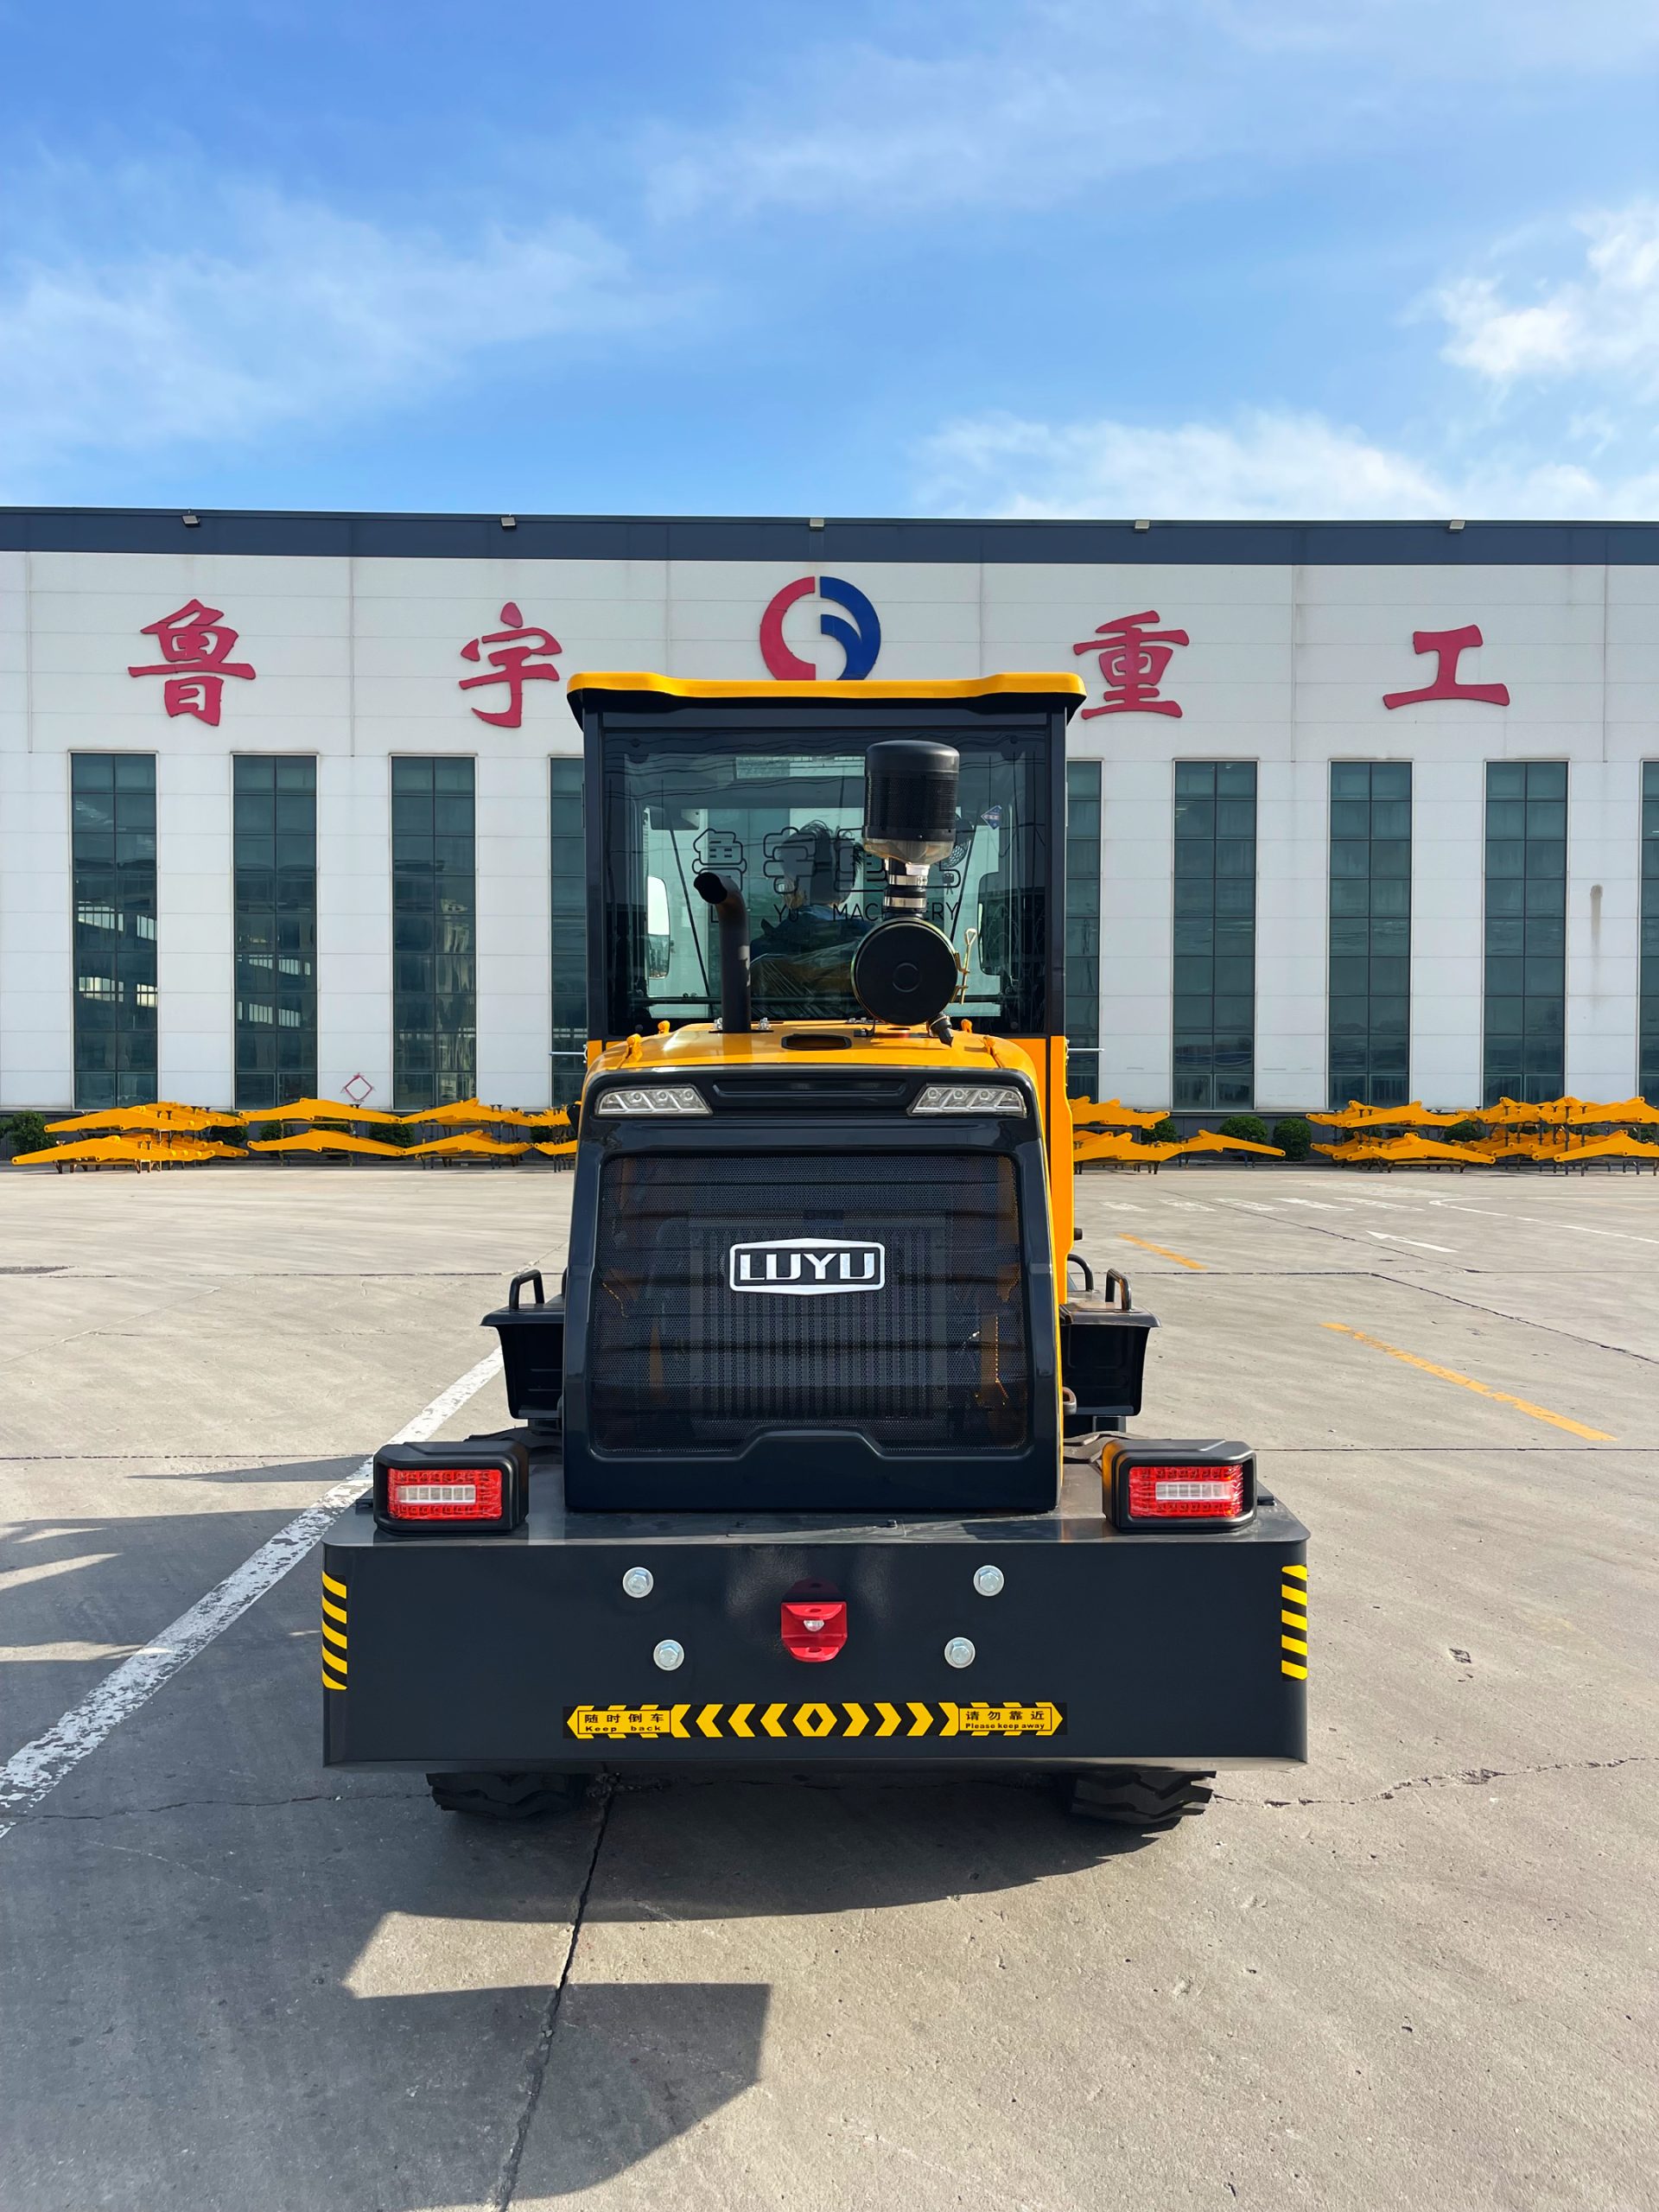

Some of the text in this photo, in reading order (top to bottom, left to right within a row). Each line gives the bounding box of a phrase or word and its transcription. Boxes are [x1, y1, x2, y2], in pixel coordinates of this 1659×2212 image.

[740, 1253, 875, 1281] LUYU
[584, 1713, 664, 1724] 随时倒车
[965, 1710, 1045, 1721] 请勿靠近
